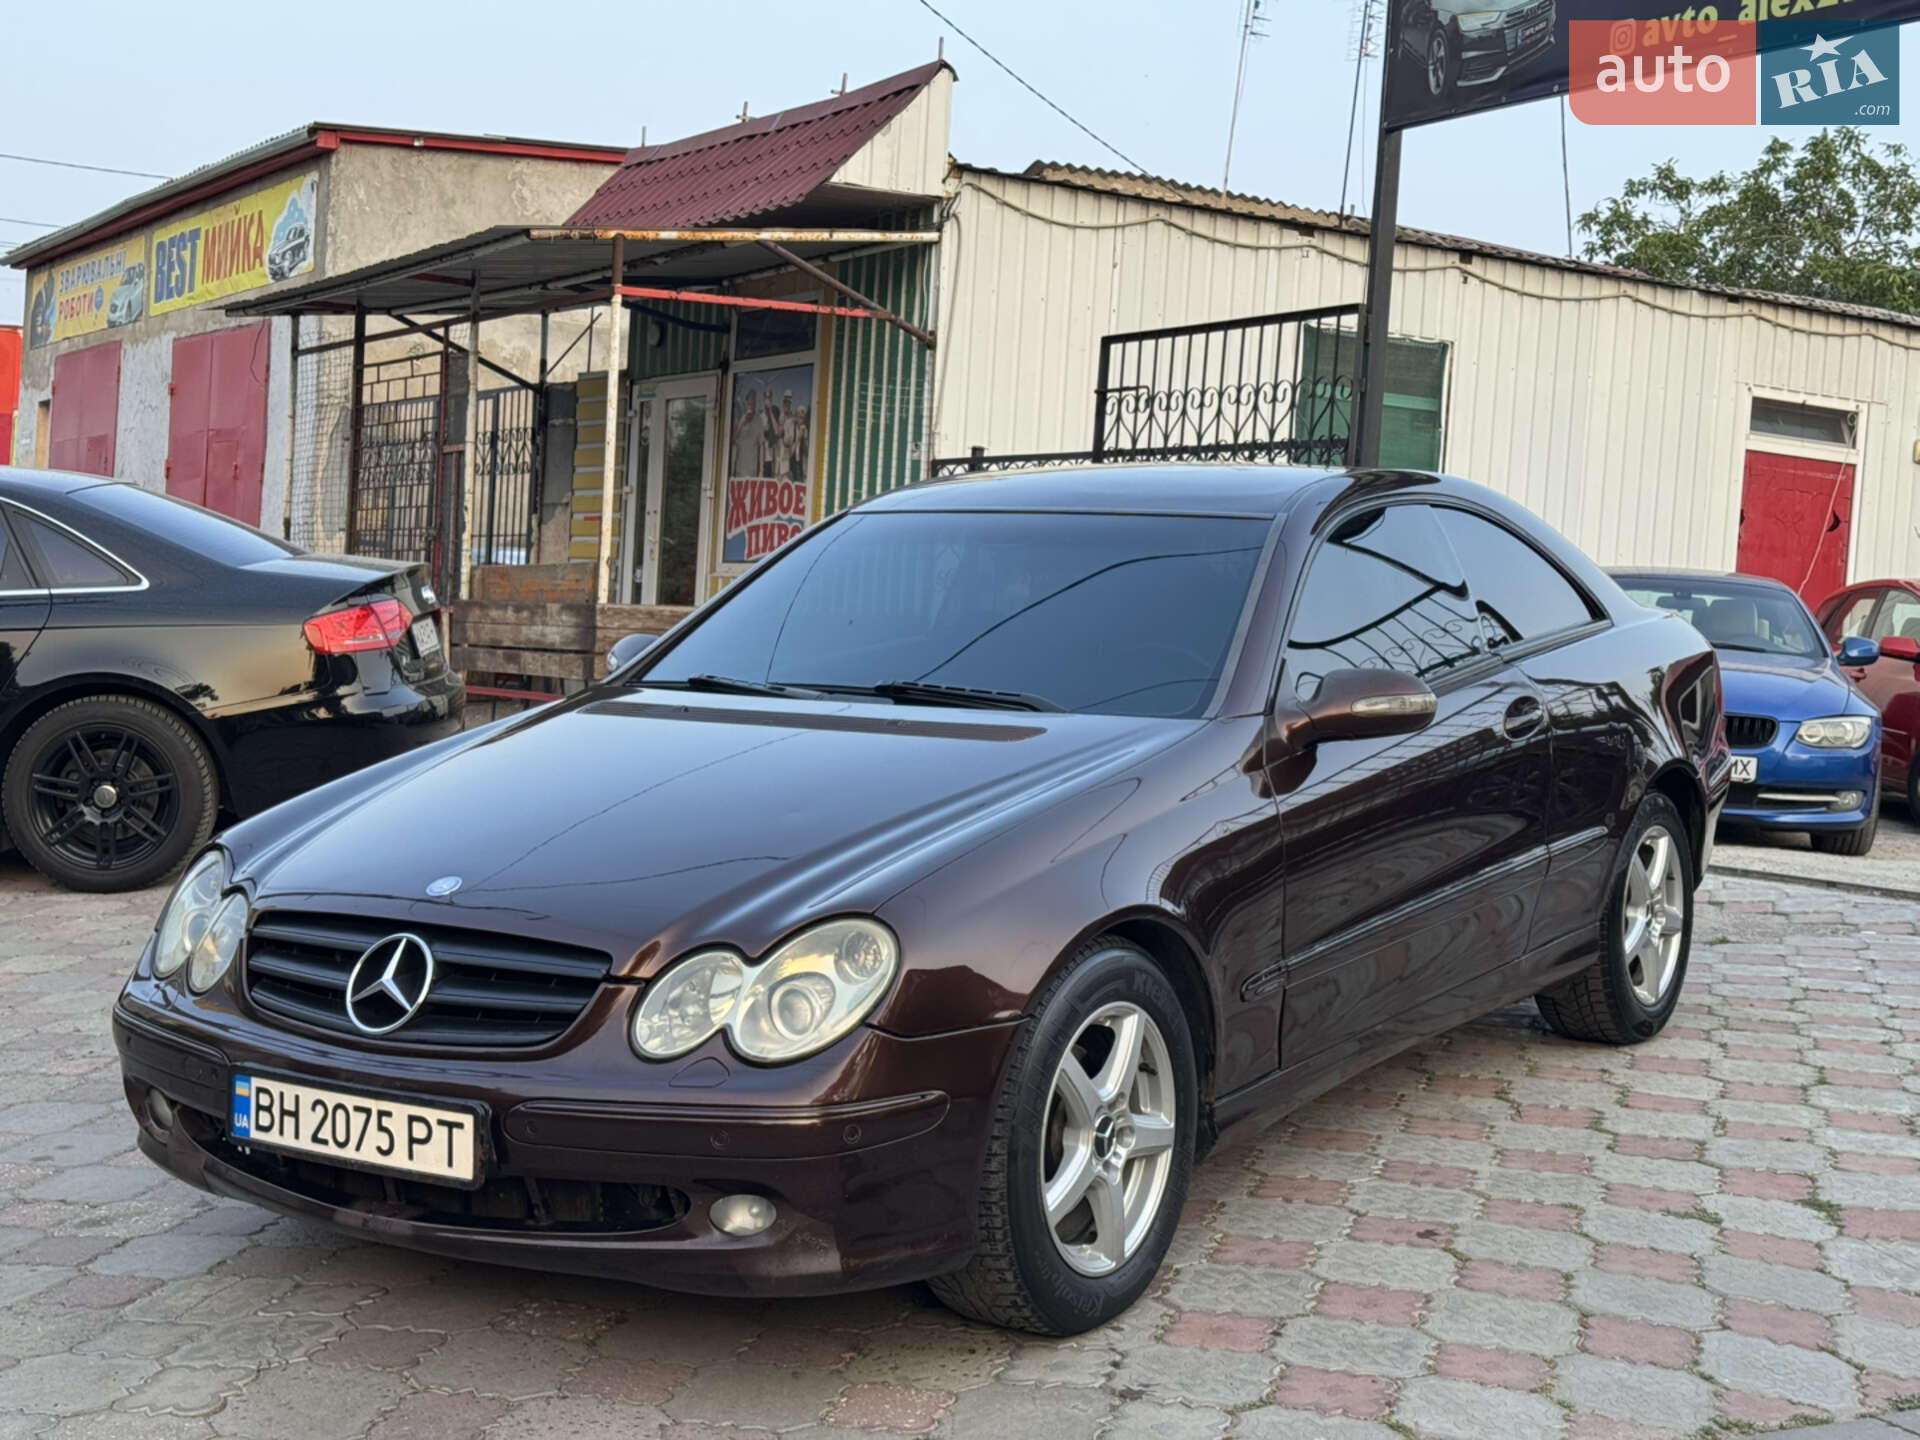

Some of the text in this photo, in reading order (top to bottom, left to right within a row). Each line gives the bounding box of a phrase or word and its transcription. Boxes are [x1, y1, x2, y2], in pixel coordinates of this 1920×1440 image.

[154, 204, 264, 304] BEST МИЙКА
[728, 480, 807, 534] ЖИВОЕ
[234, 1112, 249, 1129] UA
[255, 1086, 465, 1169] BH 2075 PT
